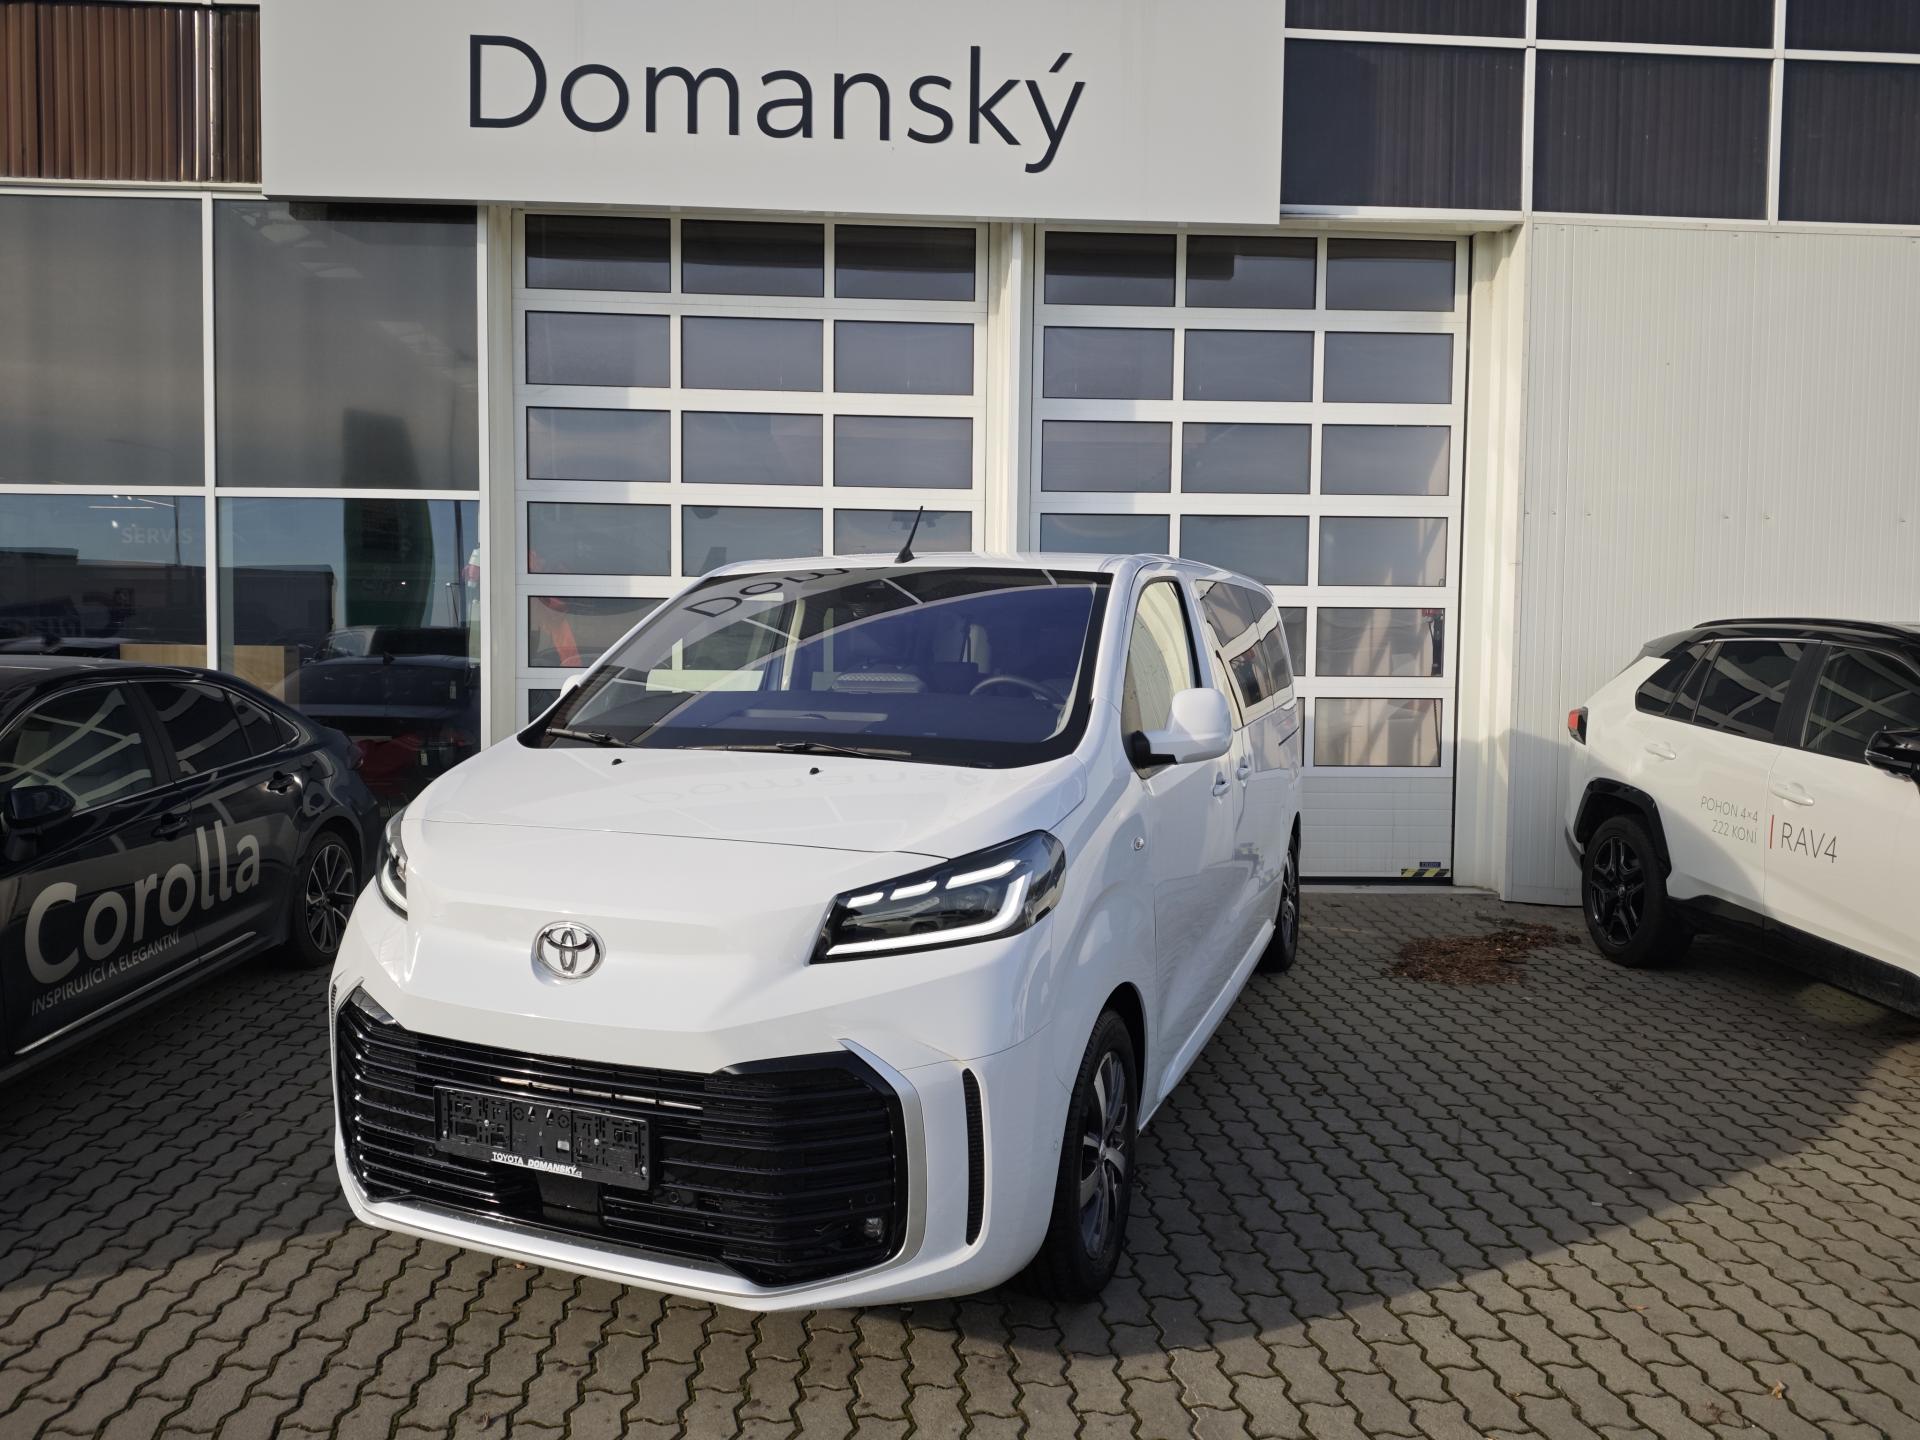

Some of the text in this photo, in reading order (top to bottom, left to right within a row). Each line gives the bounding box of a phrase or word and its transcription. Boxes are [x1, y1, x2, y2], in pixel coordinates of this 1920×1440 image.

[469, 34, 1086, 174] Domanský
[121, 527, 193, 545] SERVS
[1700, 795, 1738, 818] POHON
[1711, 819, 1729, 837] 222
[1780, 822, 1838, 864] RAV4
[24, 820, 262, 985] Corolla
[108, 961, 118, 978] A
[492, 1151, 524, 1167] TOYOTA
